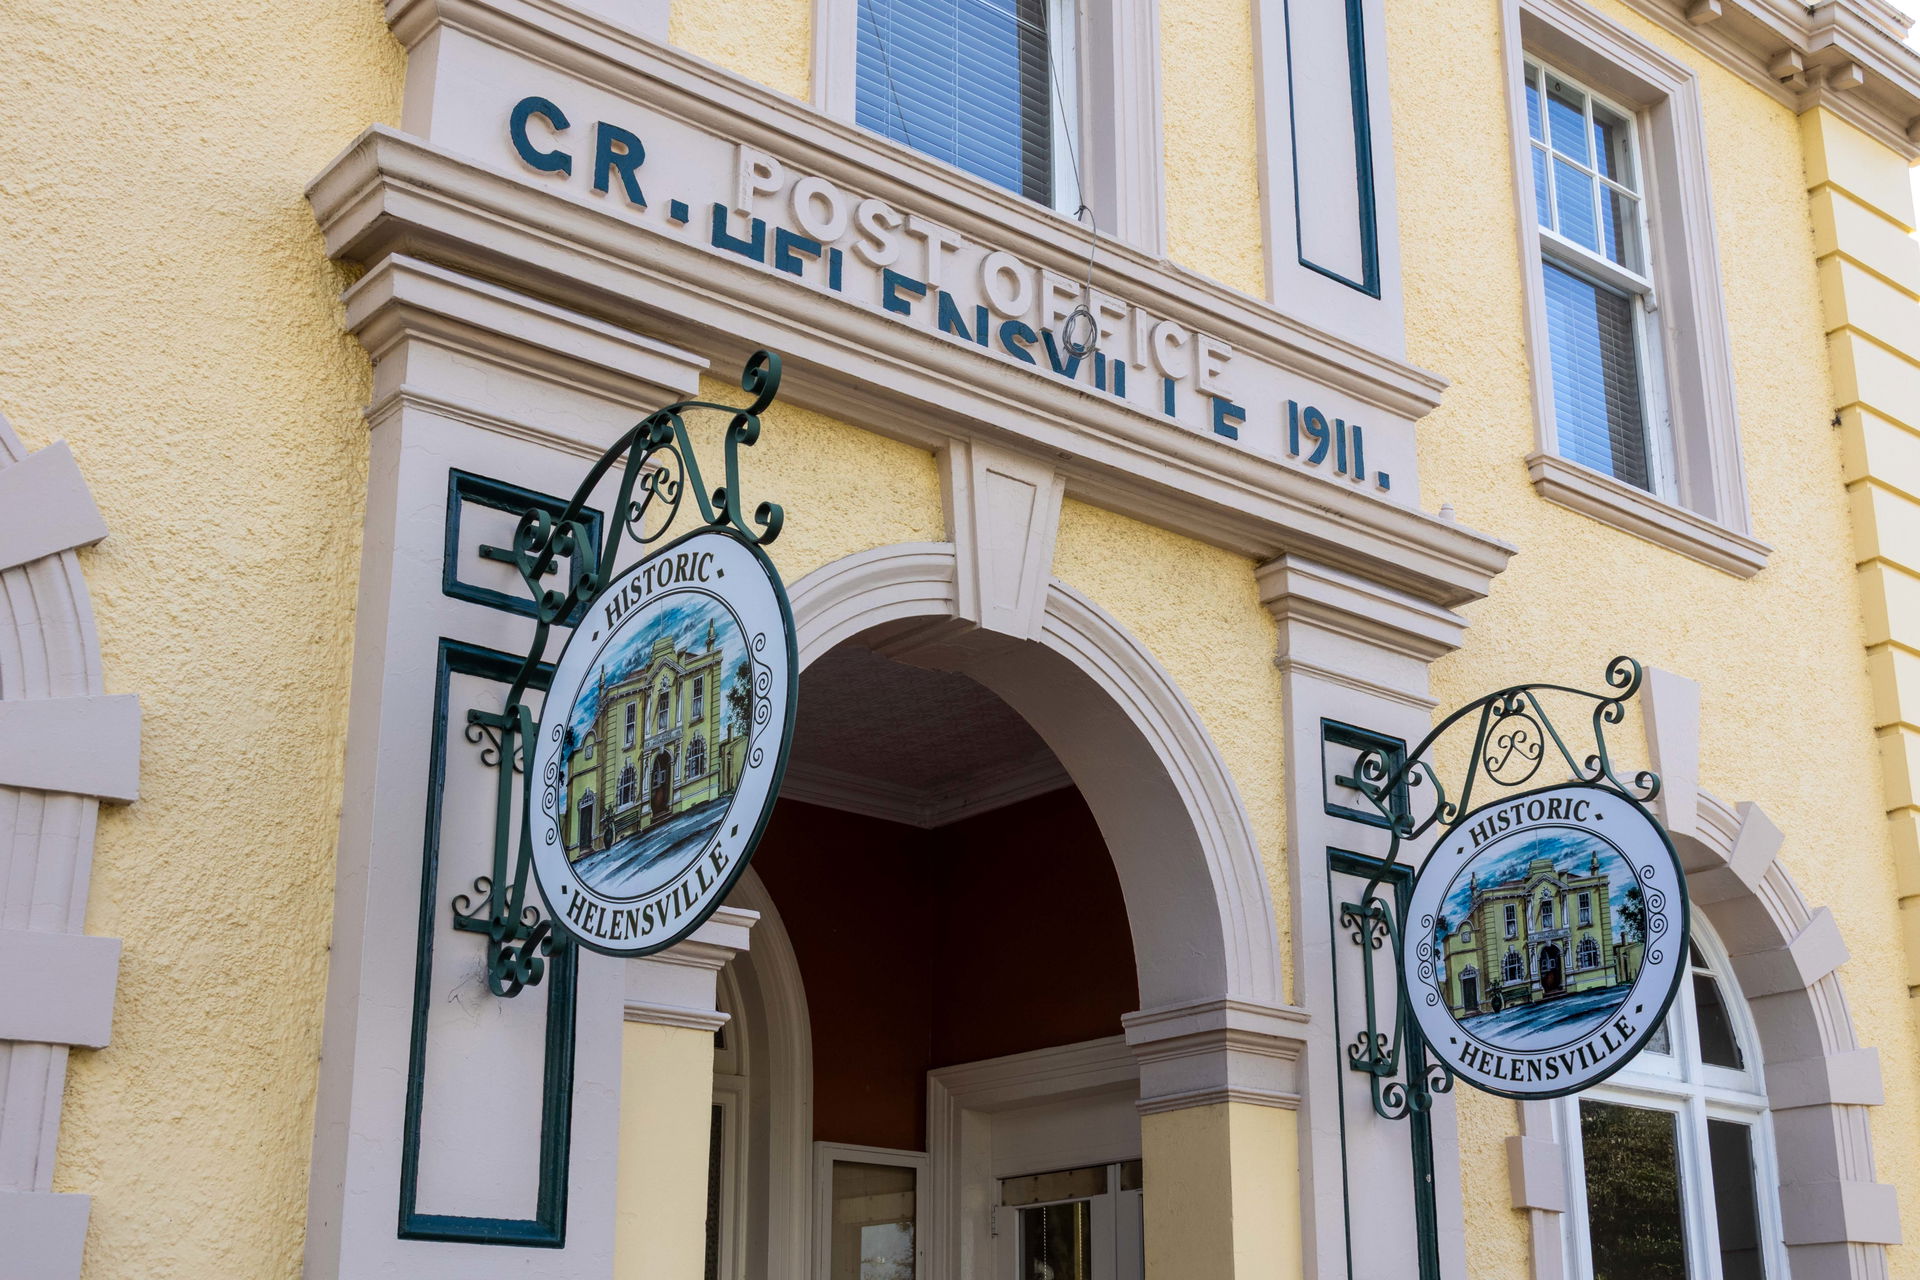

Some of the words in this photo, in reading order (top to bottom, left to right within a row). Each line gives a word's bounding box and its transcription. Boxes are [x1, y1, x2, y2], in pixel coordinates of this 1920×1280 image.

[735, 143, 961, 290] POST
[981, 250, 1233, 400] OFFICE
[1287, 399, 1391, 492] 1911.
[606, 551, 714, 632] HISTORIC
[1468, 797, 1591, 849] HISTORIC
[566, 843, 730, 941] HELENSVILLE
[1458, 1013, 1637, 1082] HELENSVILLE
